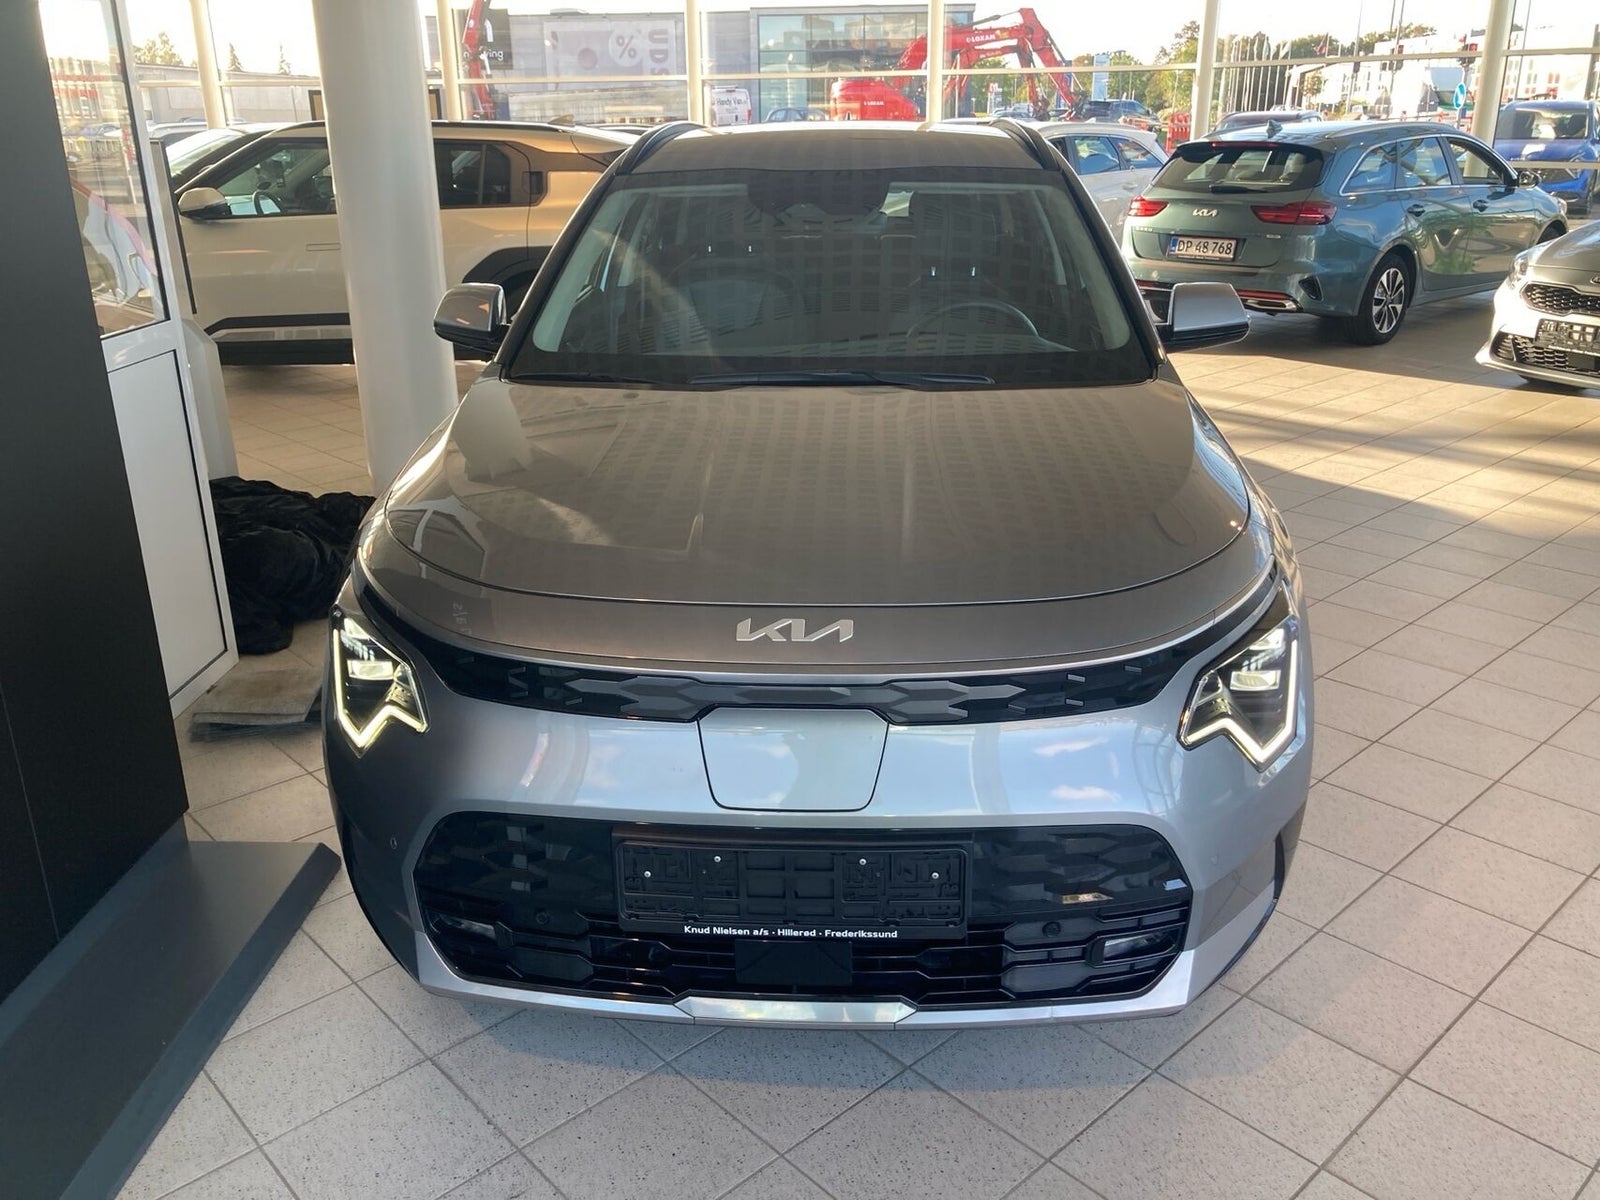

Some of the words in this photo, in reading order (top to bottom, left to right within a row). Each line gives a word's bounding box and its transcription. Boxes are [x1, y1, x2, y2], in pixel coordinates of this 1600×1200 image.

[1192, 208, 1218, 217] KIA
[1177, 239, 1193, 252] DP
[1195, 240, 1209, 253] 48
[1211, 241, 1233, 255] 768
[736, 617, 854, 642] KIA
[684, 925, 710, 934] Knud
[713, 926, 750, 935] Nielsen
[752, 928, 769, 936] a/s
[777, 928, 816, 937] Hillerød
[824, 929, 898, 938] Frederikssund
